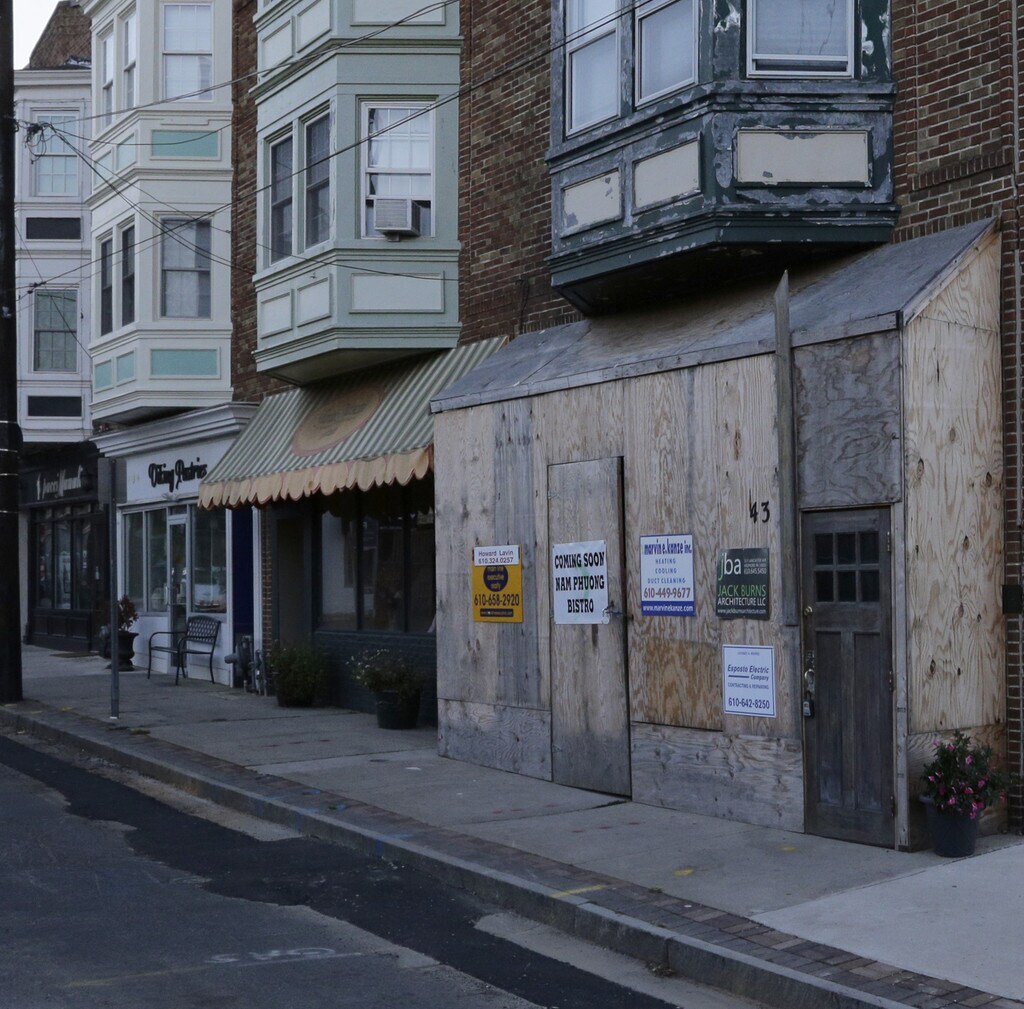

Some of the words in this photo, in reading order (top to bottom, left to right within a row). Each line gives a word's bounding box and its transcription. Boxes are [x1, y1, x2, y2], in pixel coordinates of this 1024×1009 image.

[750, 501, 770, 524] 43
[554, 553, 582, 569] COMING
[583, 551, 605, 568] SOON
[717, 552, 742, 581] jba
[555, 576, 572, 592] NAM
[573, 574, 605, 591] PHUONG
[643, 587, 691, 599] 610-449-9677
[717, 584, 739, 597] JACK
[740, 584, 767, 597] BURNS
[474, 593, 520, 606] 610-658-2920
[567, 598, 594, 613] BISTRO
[717, 597, 756, 606] ARCHITECTURE
[757, 597, 767, 607] LLC
[727, 664, 748, 674] Esposto
[749, 665, 769, 674] Electric
[750, 674, 769, 682] Company
[728, 697, 770, 709] 610-642-8250
